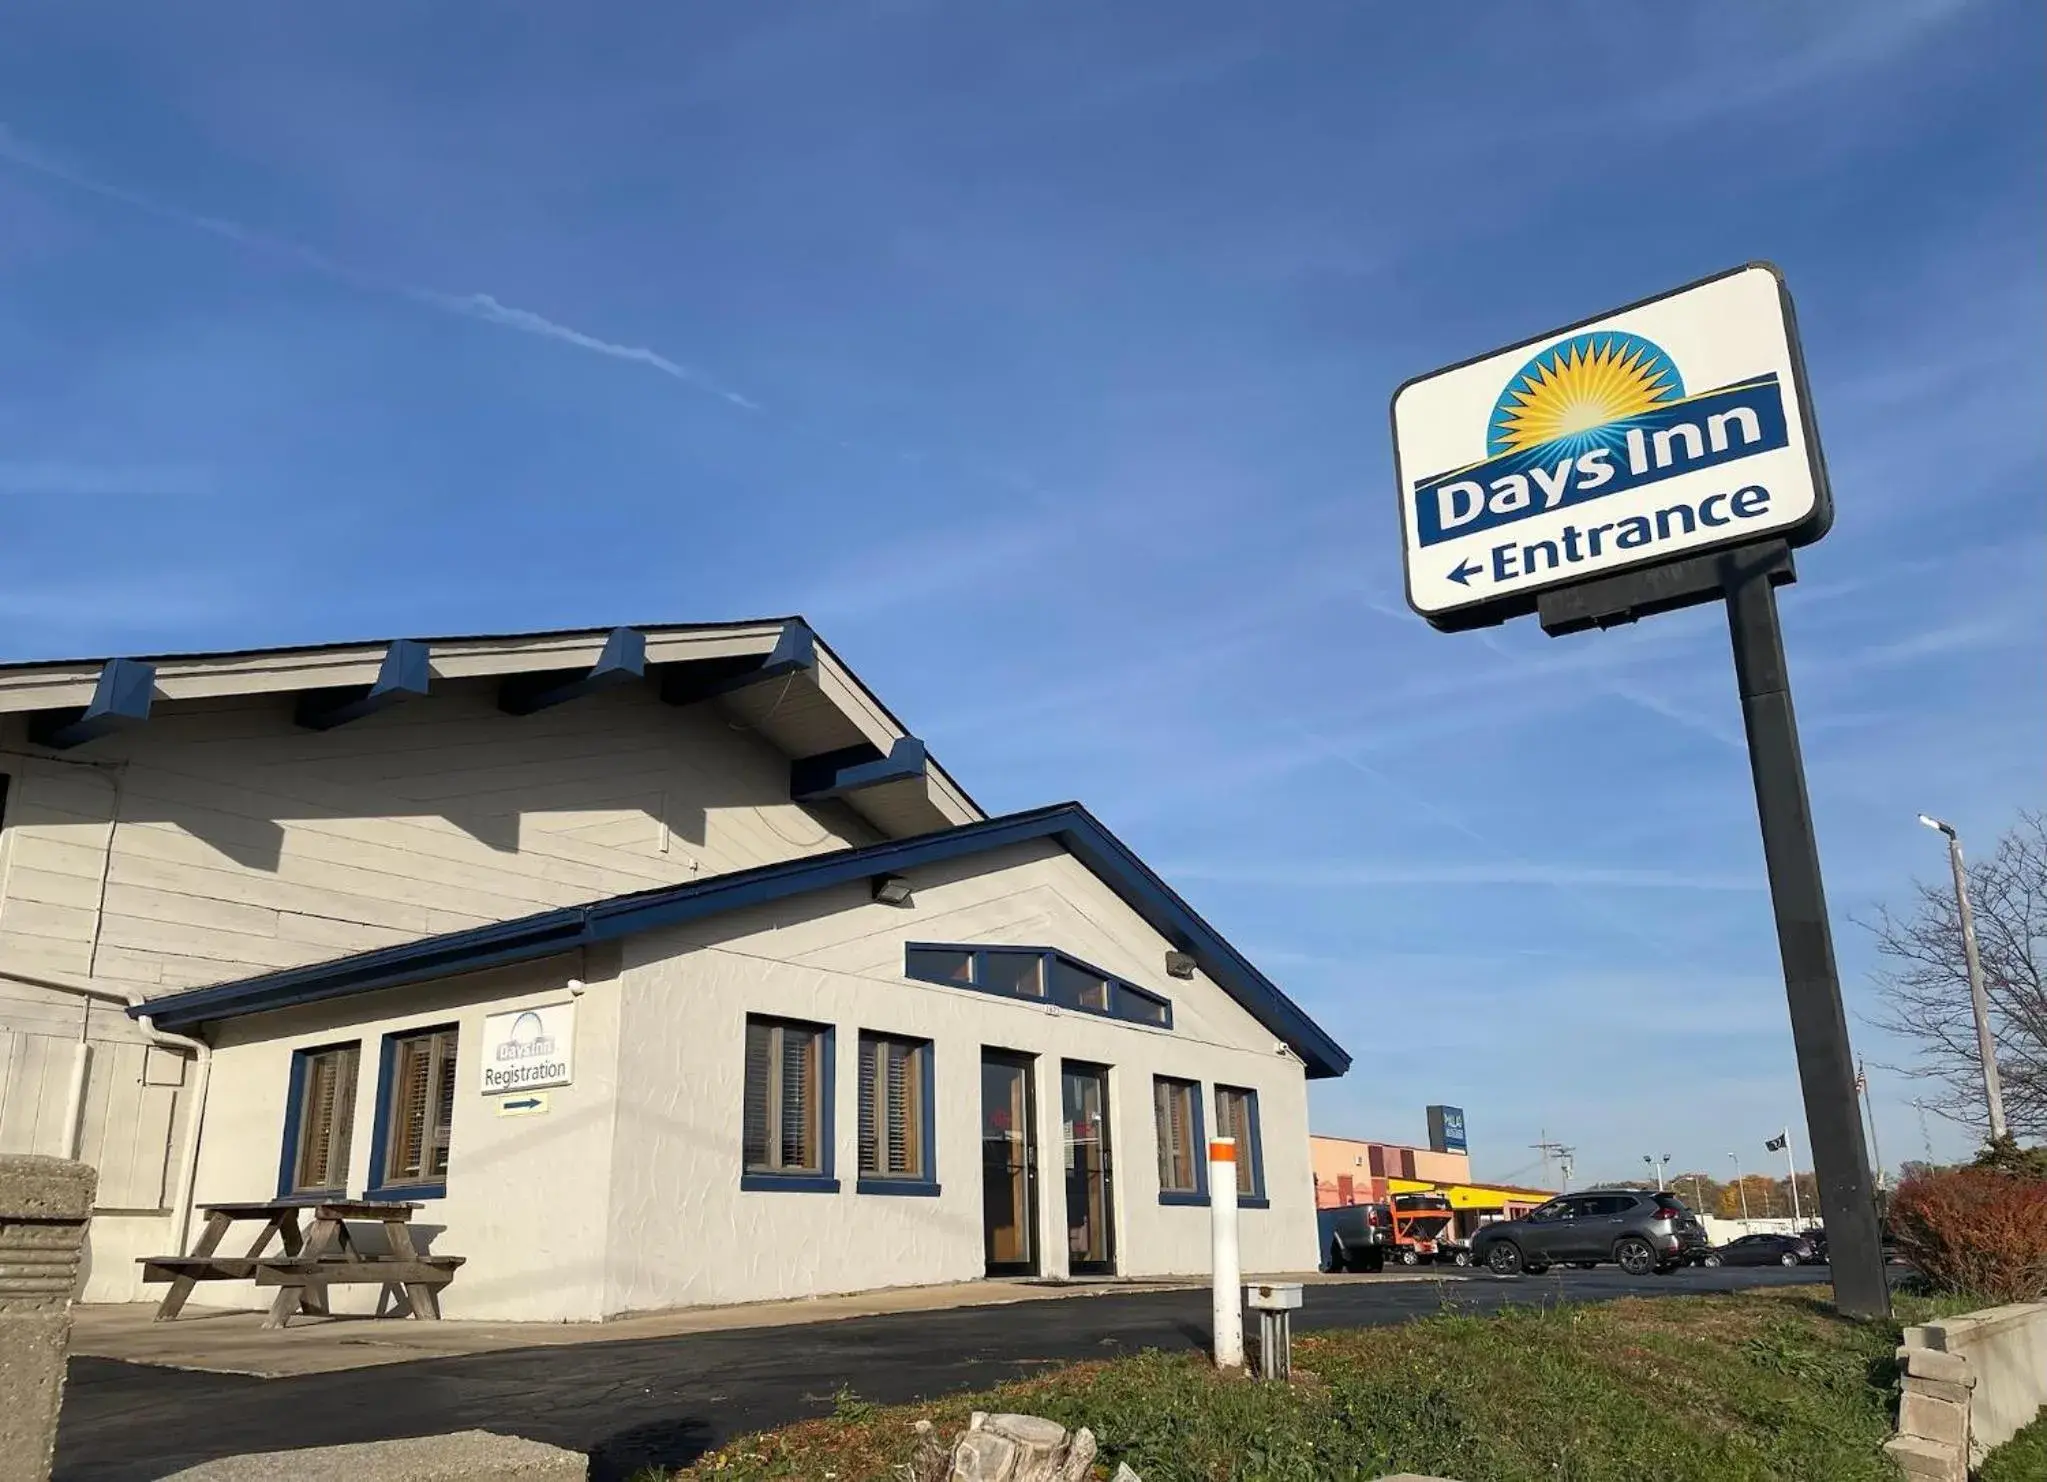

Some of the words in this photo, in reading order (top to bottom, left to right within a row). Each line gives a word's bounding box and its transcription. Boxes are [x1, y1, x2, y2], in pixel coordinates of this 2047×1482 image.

[1437, 448, 1615, 530] Days
[1627, 405, 1762, 476] Inn
[1491, 484, 1771, 583] Entrance
[485, 1059, 566, 1089] Registration
